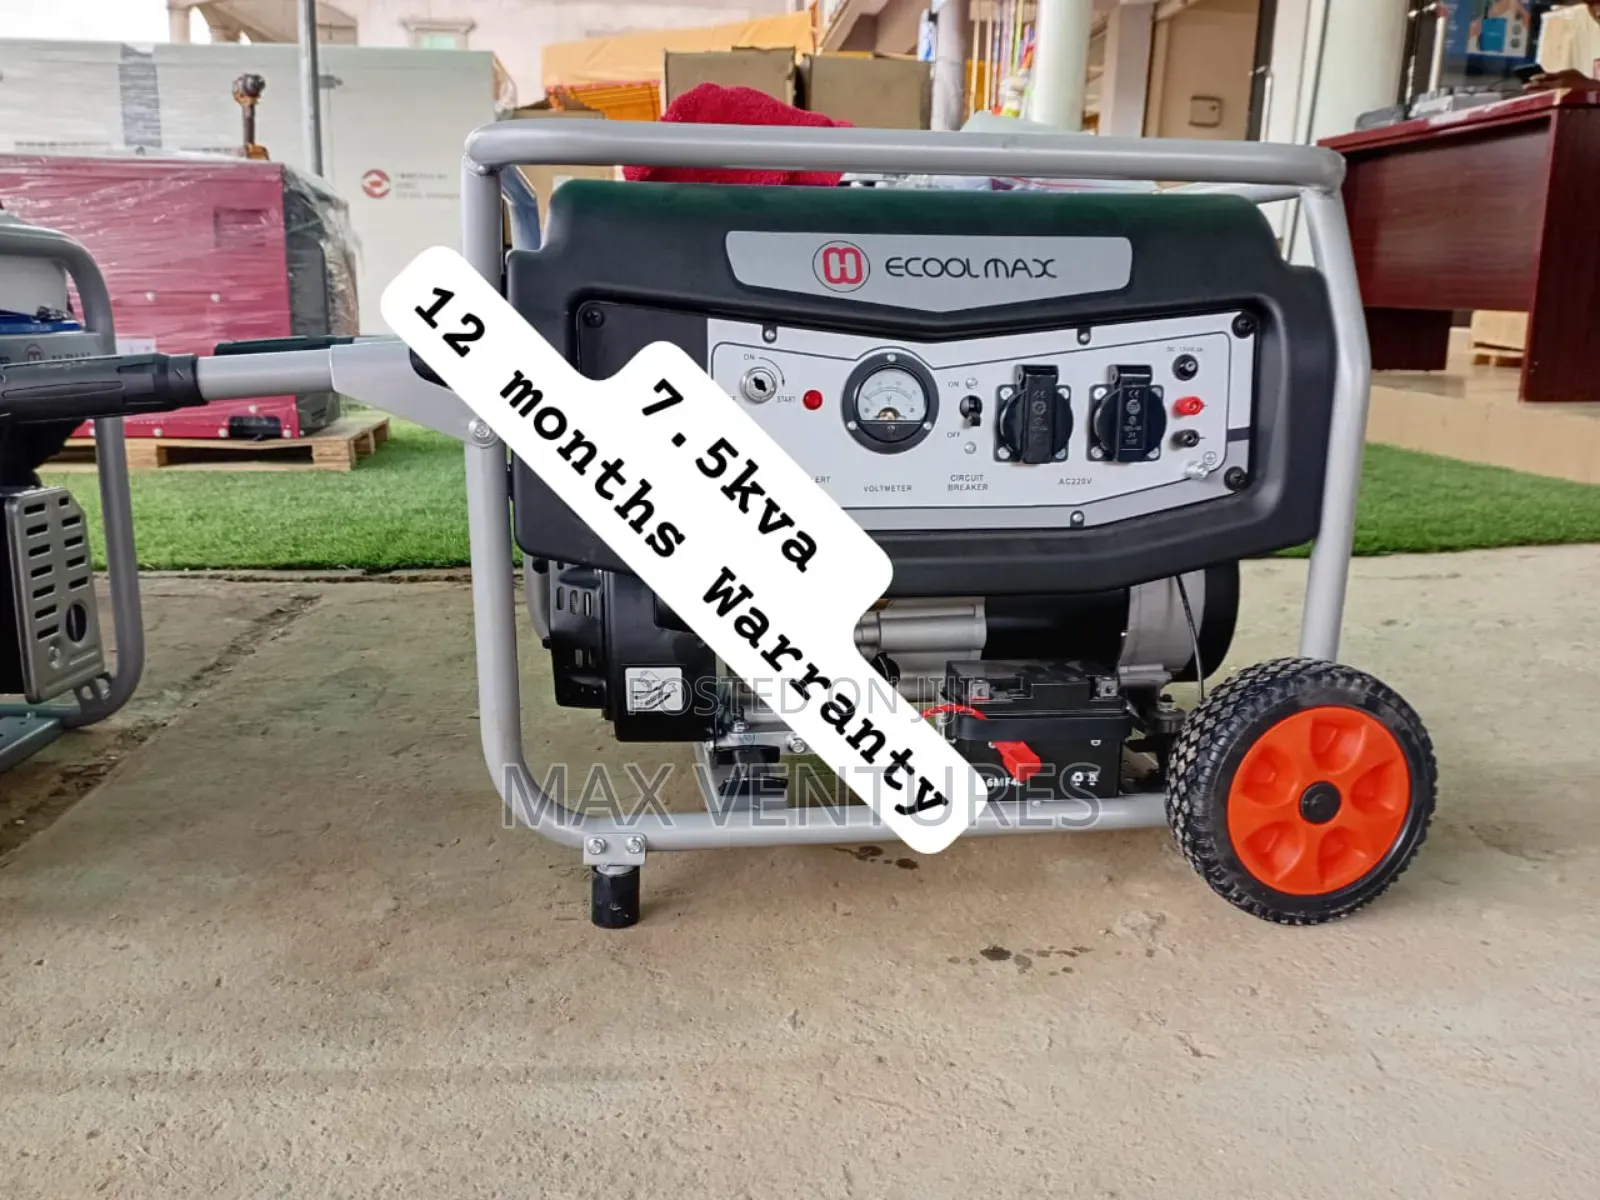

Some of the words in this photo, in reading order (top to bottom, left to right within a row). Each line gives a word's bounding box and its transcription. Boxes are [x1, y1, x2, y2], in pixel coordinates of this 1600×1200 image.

[814, 476, 831, 484] ERT
[950, 474, 984, 482] CIRCUIT
[863, 484, 912, 493] VOLTMETER
[947, 483, 989, 491] BREAKER
